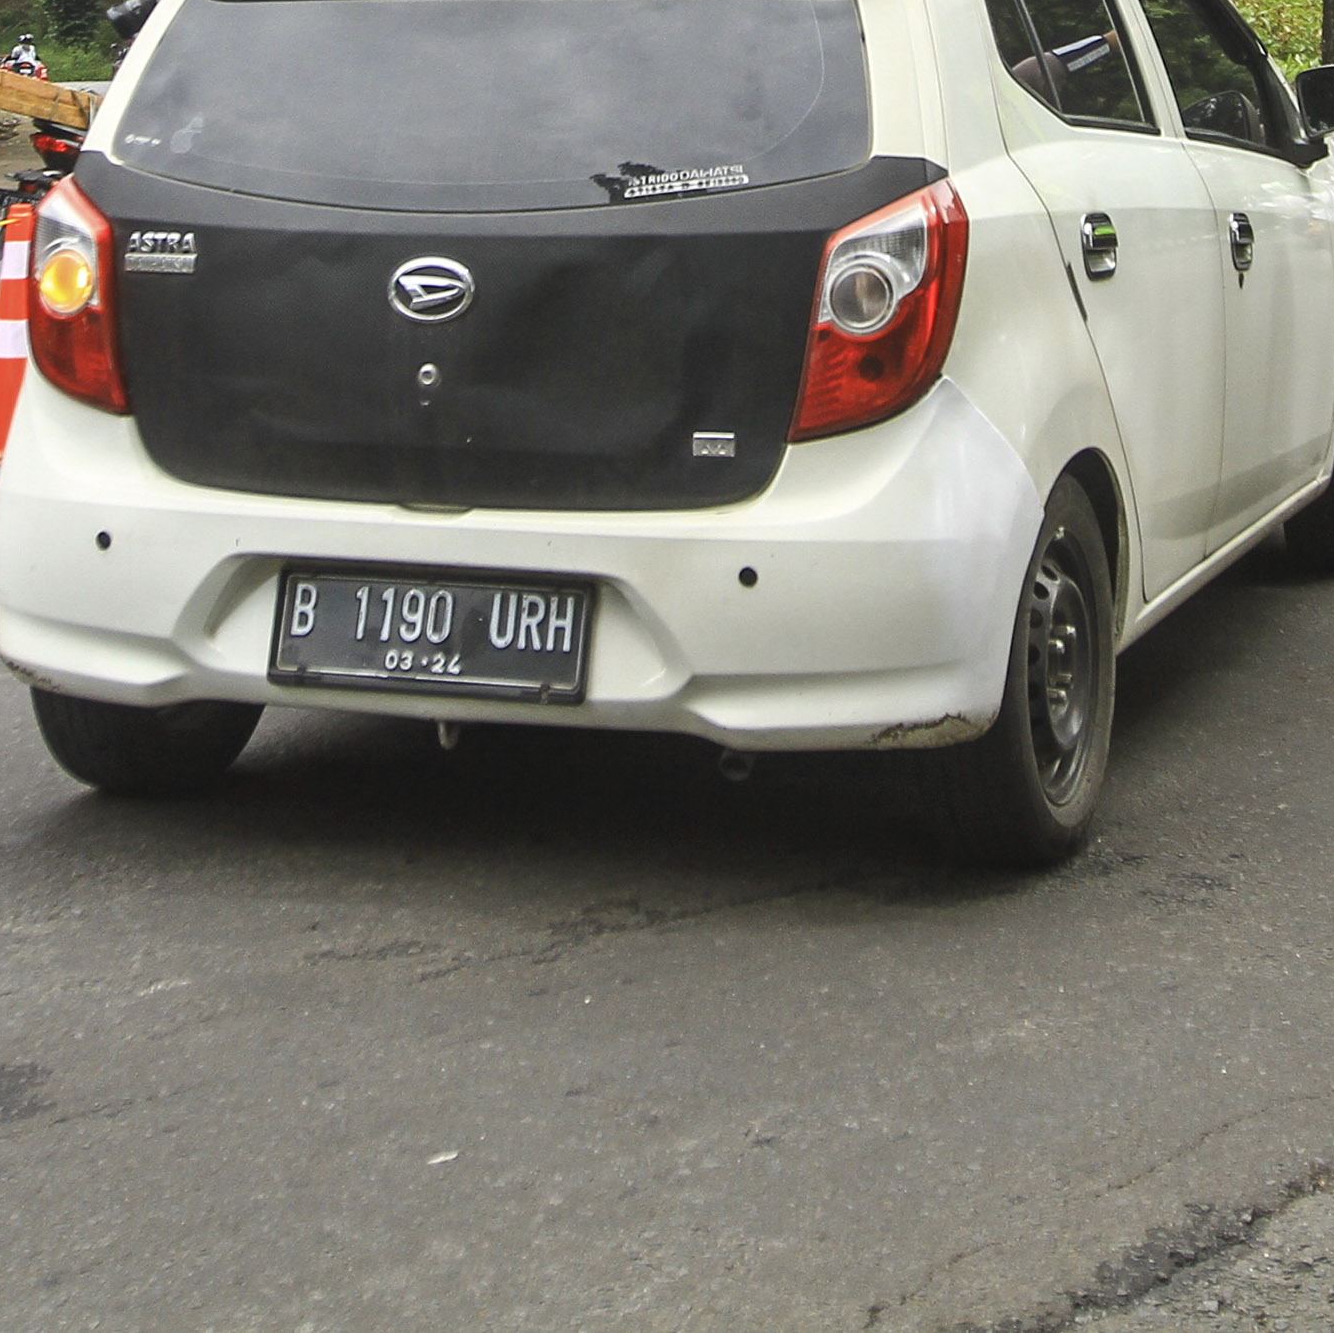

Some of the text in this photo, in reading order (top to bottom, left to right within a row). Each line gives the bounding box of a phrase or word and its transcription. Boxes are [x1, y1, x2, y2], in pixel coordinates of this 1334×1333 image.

[128, 230, 195, 253] ASTRA
[289, 582, 576, 653] B 1190 URH
